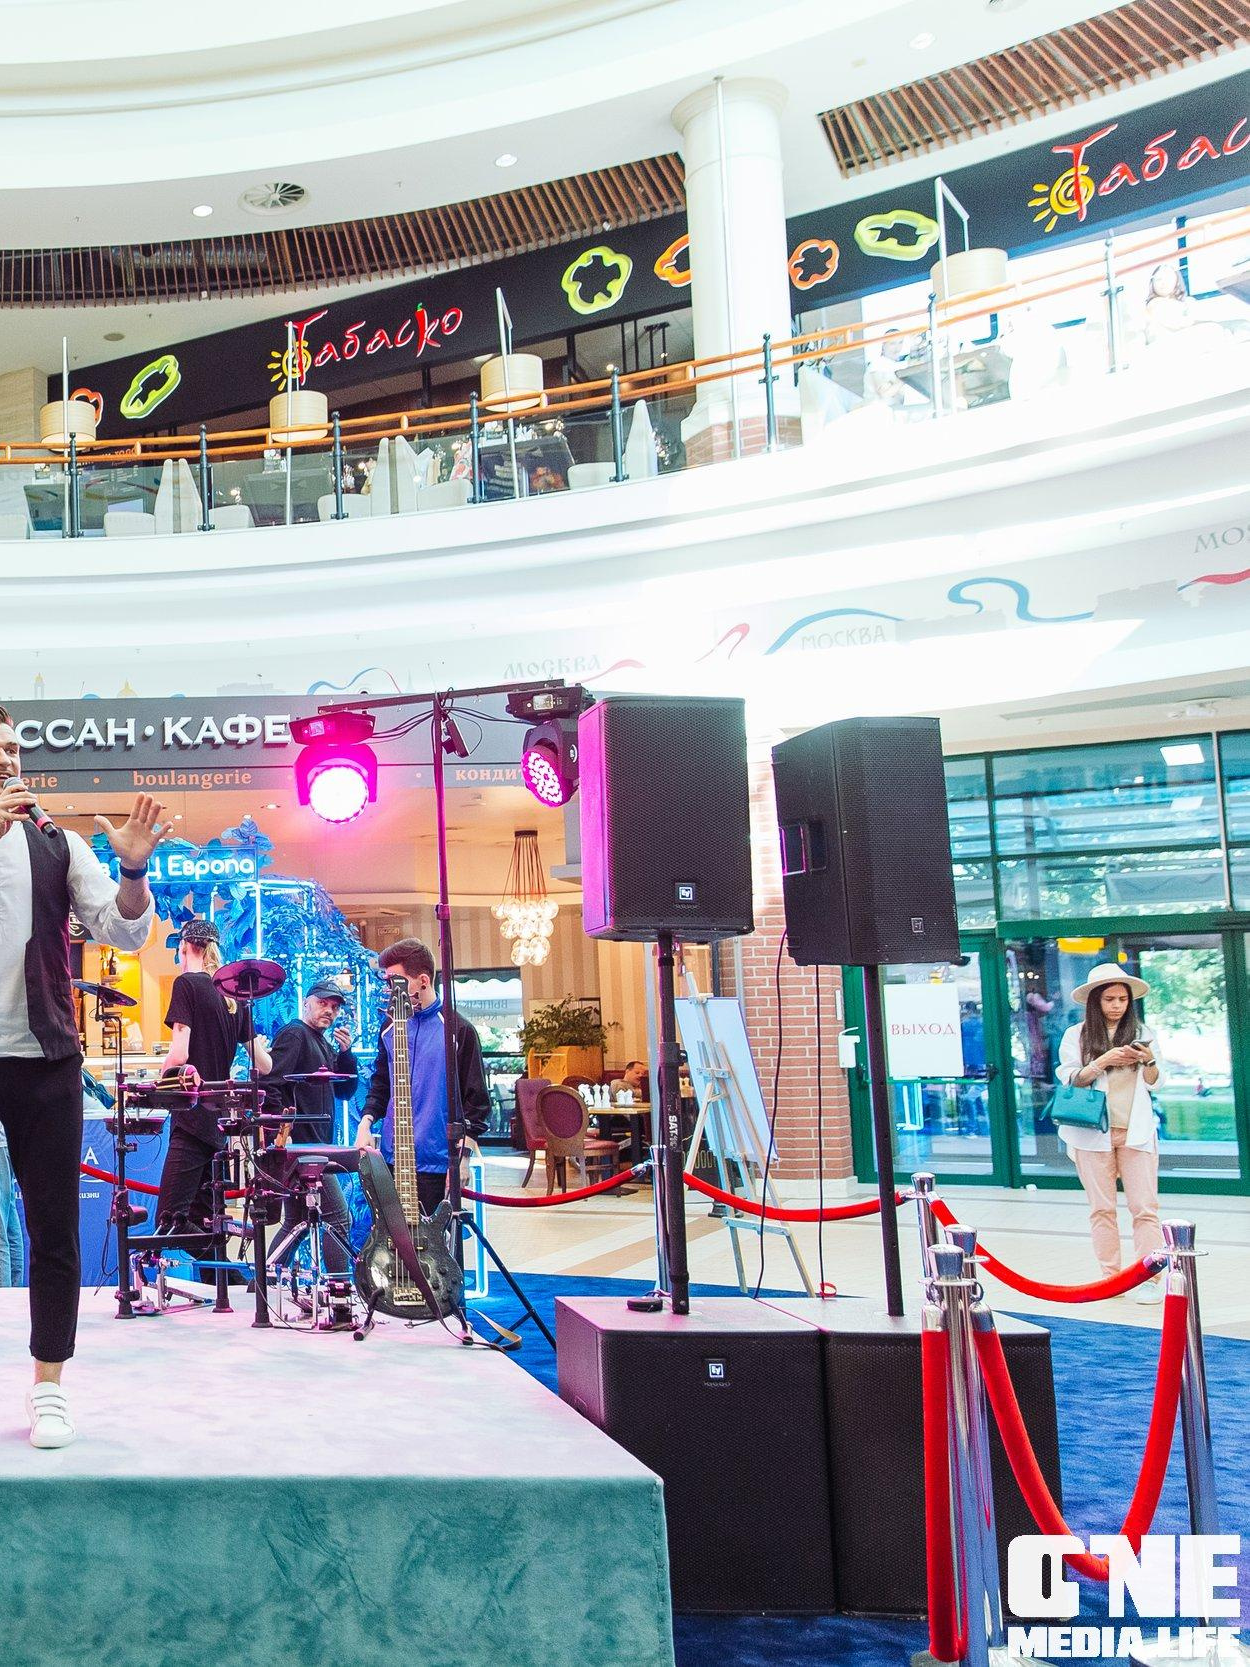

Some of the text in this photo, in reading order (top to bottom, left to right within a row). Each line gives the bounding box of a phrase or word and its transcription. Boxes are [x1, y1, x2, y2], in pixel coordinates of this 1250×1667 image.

[285, 303, 463, 386] Табаско
[163, 713, 292, 747] КАФЕ
[133, 770, 252, 789] boulangerie
[167, 854, 255, 881] Европа
[891, 1023, 957, 1036] ВЫХОД
